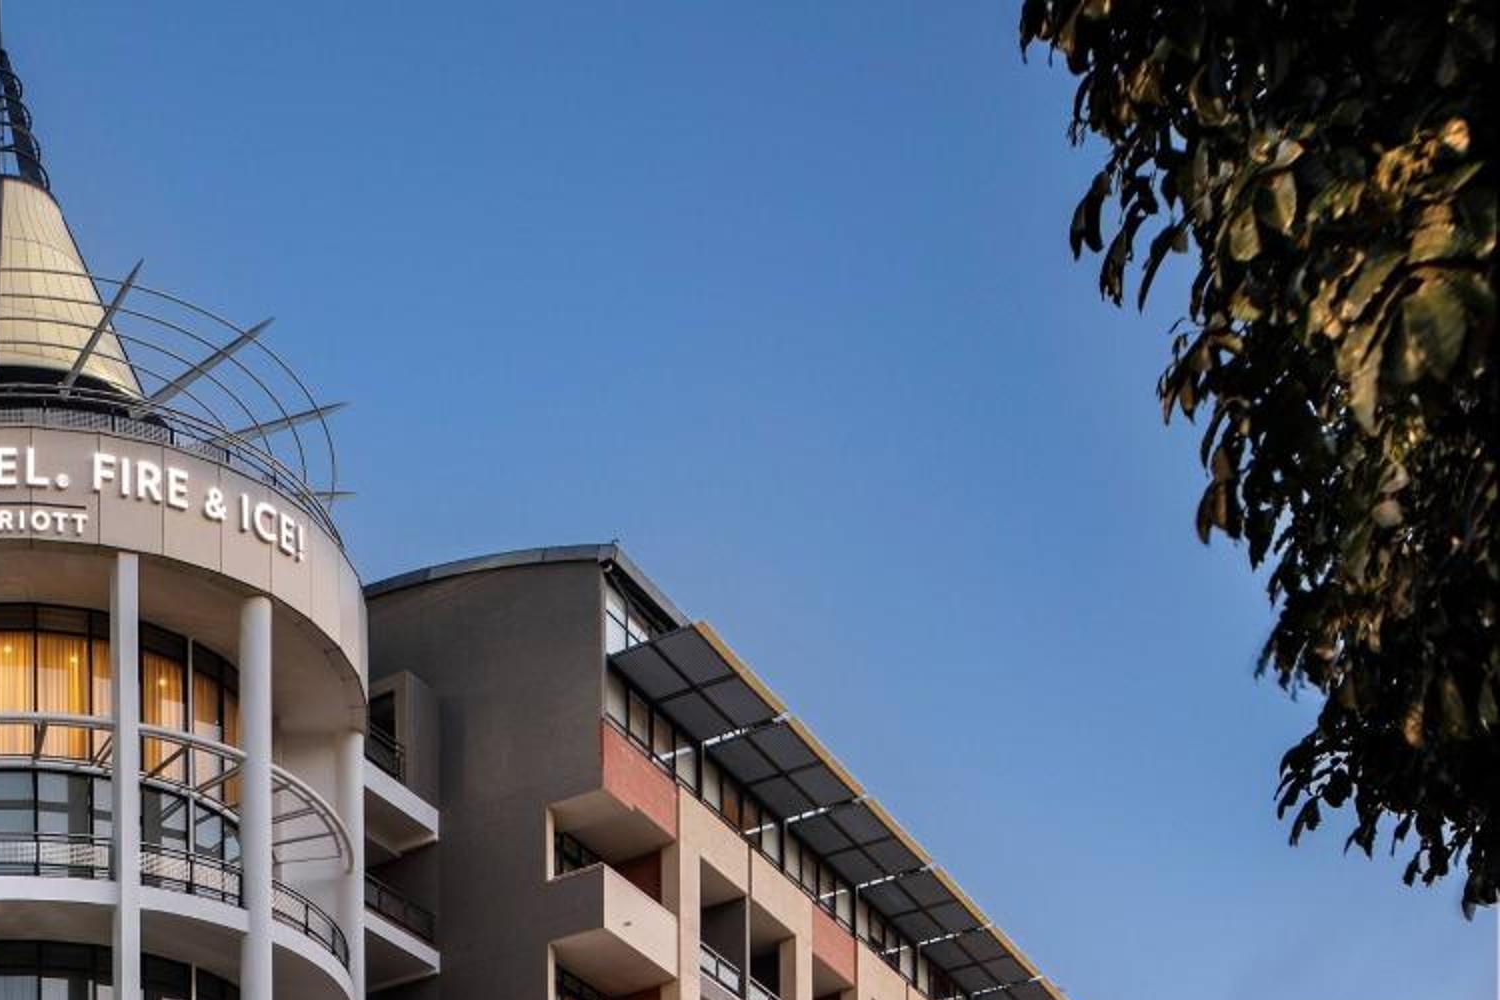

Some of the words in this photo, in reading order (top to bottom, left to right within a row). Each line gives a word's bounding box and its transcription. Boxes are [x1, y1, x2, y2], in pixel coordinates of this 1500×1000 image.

[92, 451, 190, 510] FIRE
[203, 485, 228, 521] &
[240, 492, 306, 561] ICE!
